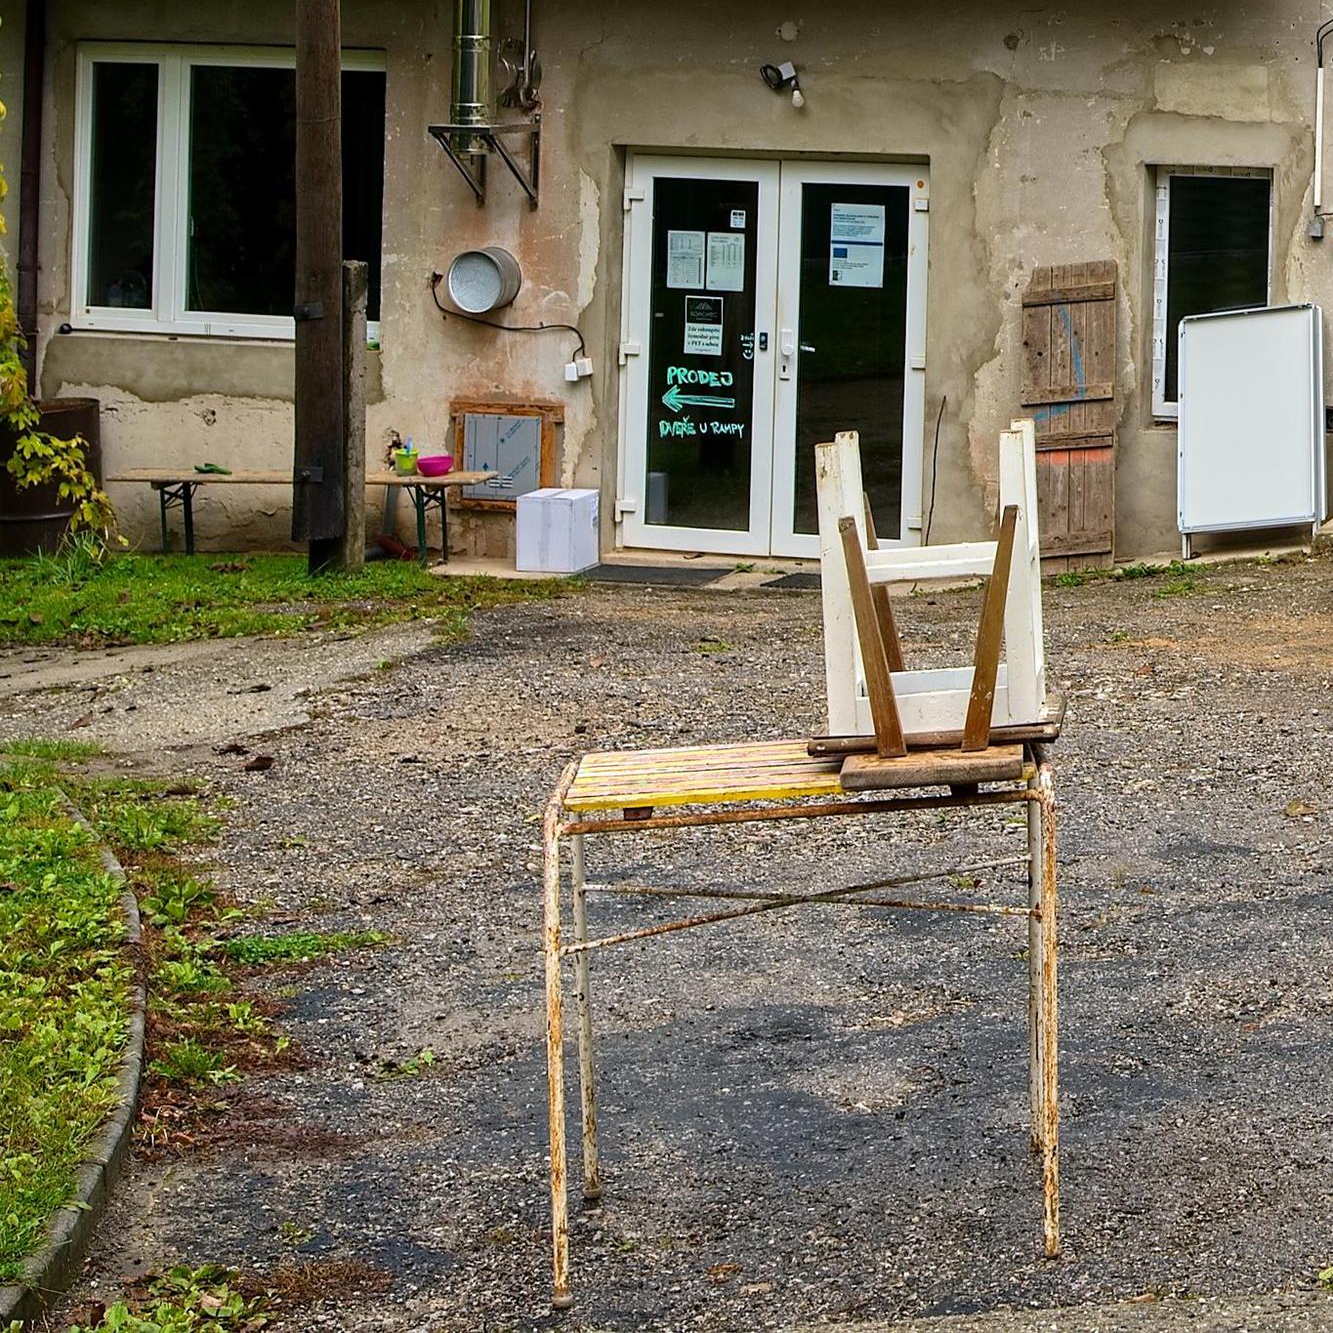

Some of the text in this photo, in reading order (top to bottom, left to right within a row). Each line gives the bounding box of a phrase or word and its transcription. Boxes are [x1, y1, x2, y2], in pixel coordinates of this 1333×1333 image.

[667, 366, 733, 387] PRODEJ
[659, 415, 745, 439] DVEŘE U RAMPY
